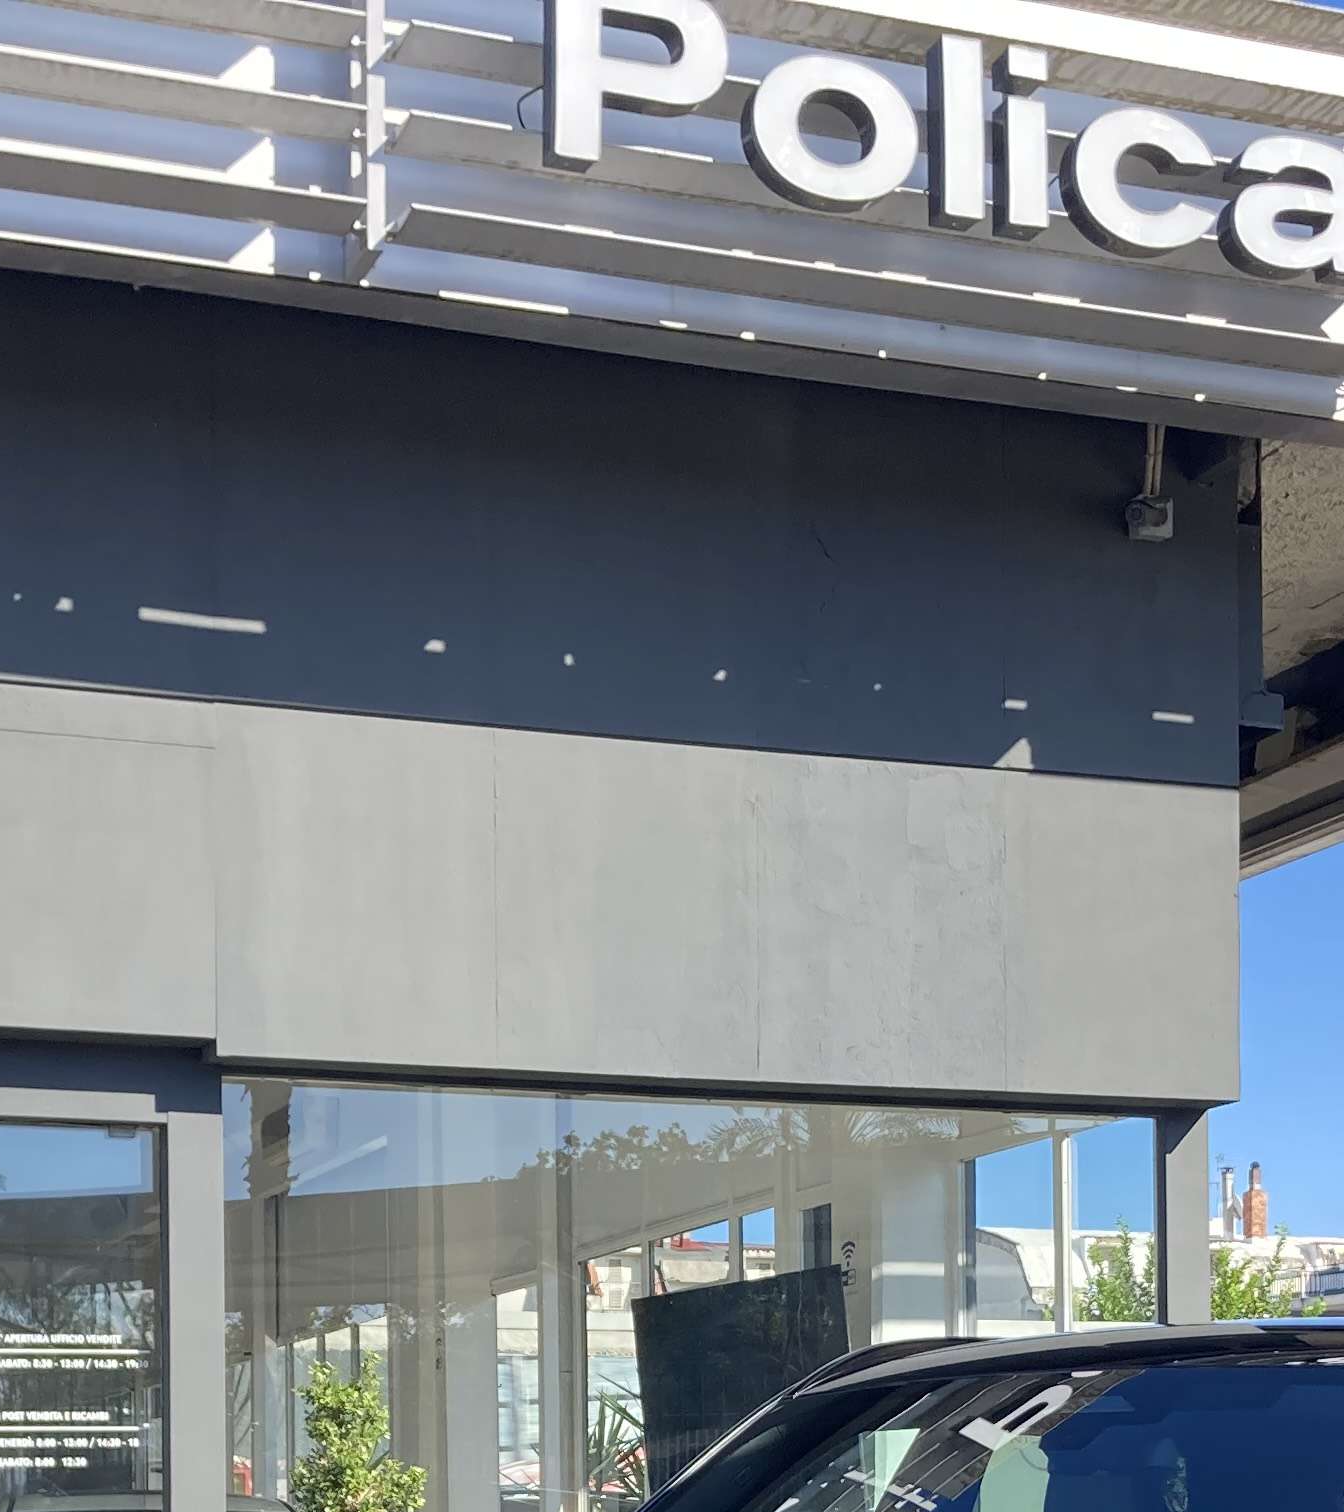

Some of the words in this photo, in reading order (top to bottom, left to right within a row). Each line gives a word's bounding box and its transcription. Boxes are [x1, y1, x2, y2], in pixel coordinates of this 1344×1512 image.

[4, 1333, 50, 1344] APERTURA
[50, 1334, 85, 1344] UFFICIO
[85, 1334, 123, 1345] VENDITE
[59, 1359, 85, 1369] 13:00
[93, 1359, 118, 1369] 14:30
[1, 1411, 26, 1421] POST
[26, 1411, 64, 1421] VENDITA
[71, 1411, 110, 1421] RICAMBI
[62, 1438, 88, 1448] 13:00
